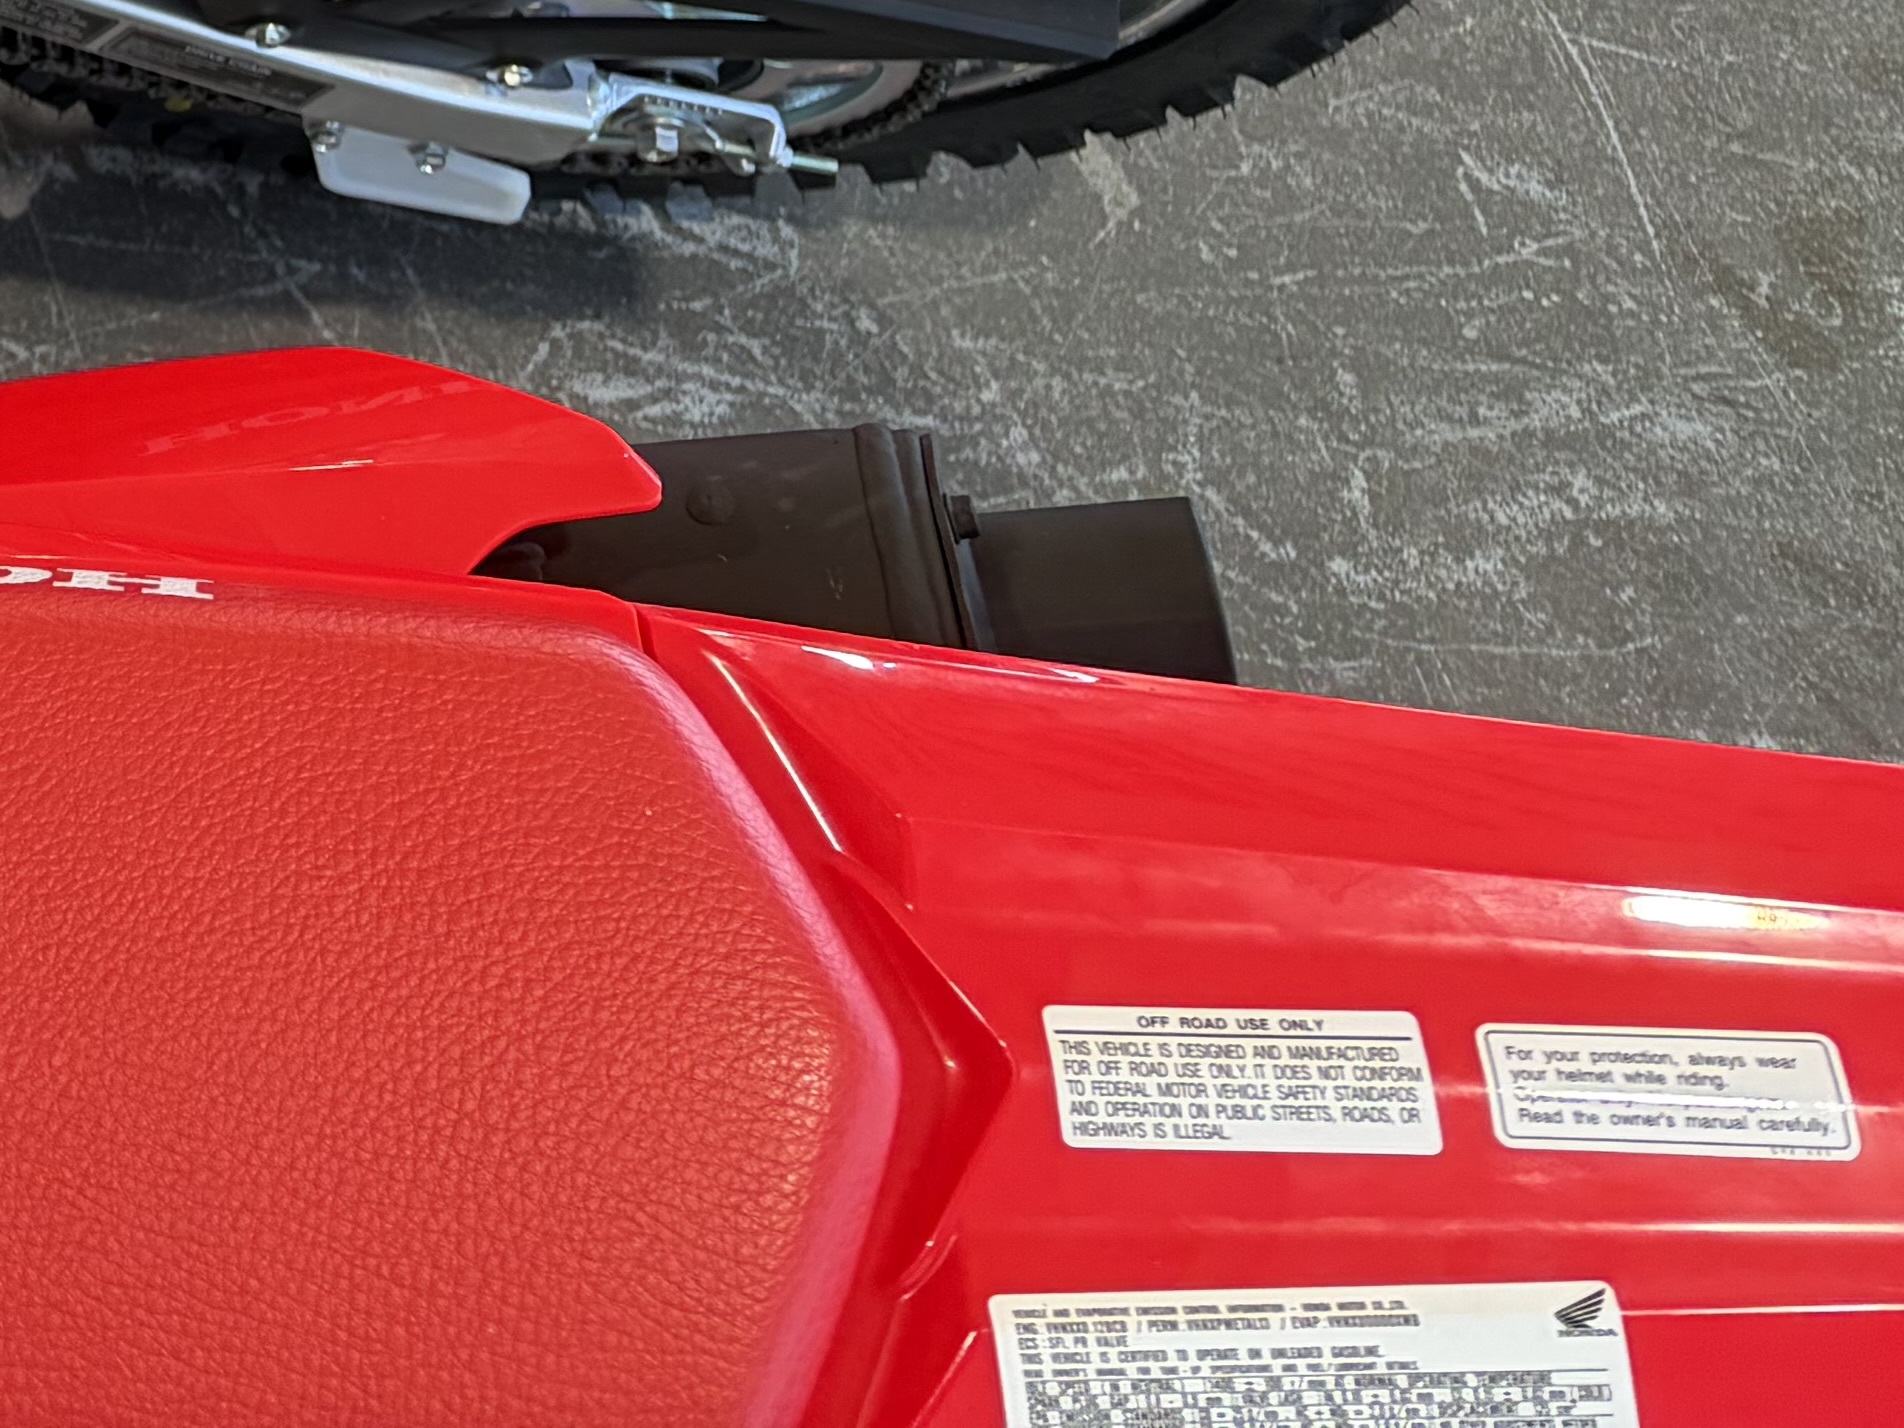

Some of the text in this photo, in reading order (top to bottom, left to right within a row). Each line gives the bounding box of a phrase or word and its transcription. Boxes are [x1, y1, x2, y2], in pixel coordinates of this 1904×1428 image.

[1136, 1015, 1325, 1032] OFF ROAD USE ONLY
[1058, 1039, 1400, 1062] THIS VEHICLE IS DESIGNED AND MANUFACTURED
[1504, 1045, 1799, 1071] For your protection, always wear
[1063, 1059, 1092, 1076] FOR
[1097, 1060, 1123, 1077] OFF
[1128, 1061, 1169, 1078] ROAD
[1174, 1062, 1204, 1078] USE
[1253, 1063, 1267, 1080] IT
[1273, 1064, 1312, 1081] DOES
[1317, 1065, 1347, 1081] NOT
[1352, 1065, 1424, 1083] CONFORM
[1508, 1068, 1731, 1092] your helmet while riding.
[1065, 1079, 1420, 1103] TO FEDERAL MOTOR VEHICLE SAFETY STANDARDS
[1069, 1100, 1422, 1125] AND OPERATION ON PUBLIC STREETS, ROADS, OR
[1518, 1107, 1838, 1137] Read the owner's manual carefully.
[1072, 1120, 1147, 1138] HIGHWAYS
[1152, 1121, 1167, 1139] IS
[1557, 1328, 1619, 1338] HONDA
